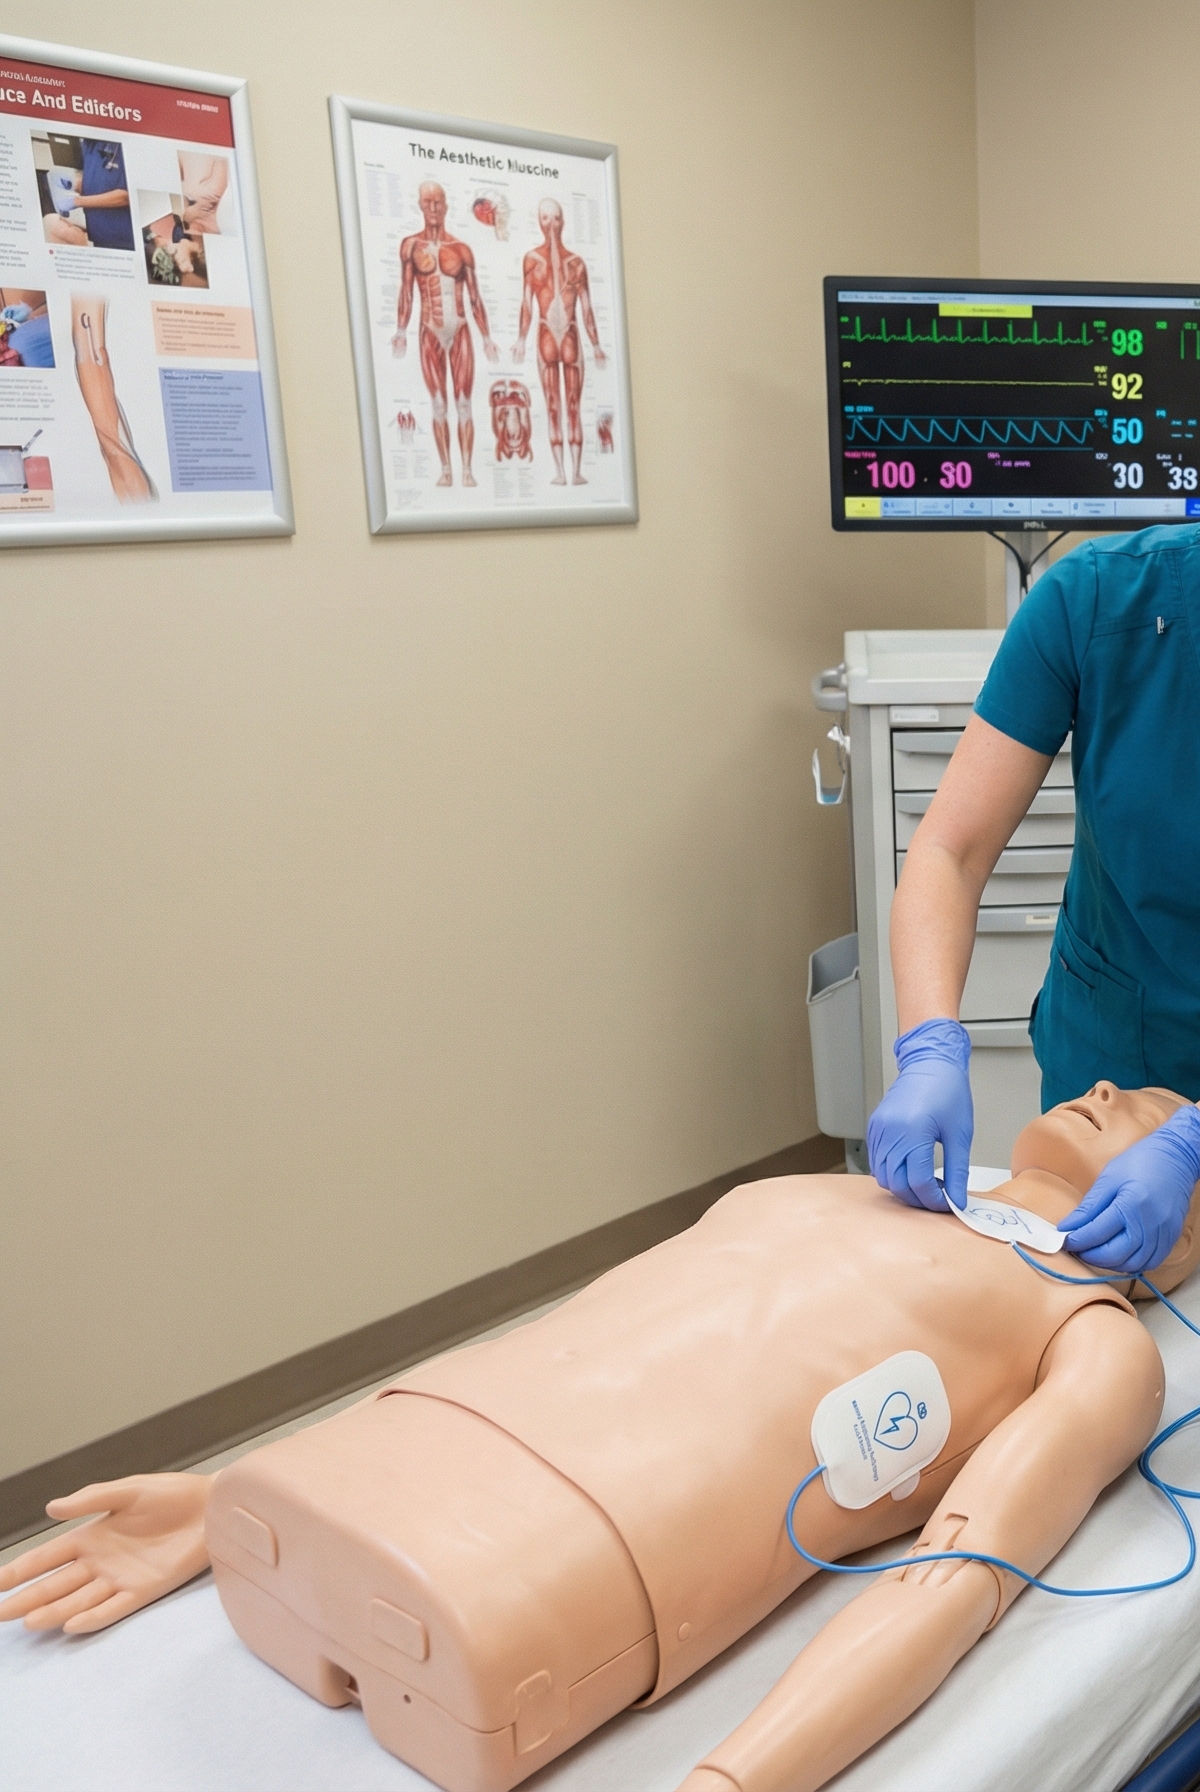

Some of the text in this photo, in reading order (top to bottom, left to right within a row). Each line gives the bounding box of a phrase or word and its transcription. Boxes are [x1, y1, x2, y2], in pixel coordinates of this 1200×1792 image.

[31, 89, 67, 110] And
[408, 142, 435, 160] The
[439, 147, 504, 171] Aesthetic
[1111, 328, 1143, 356] 98
[1111, 372, 1143, 400] 92
[1111, 418, 1143, 445] 50
[866, 461, 915, 489] 100
[1112, 462, 1144, 490] 30
